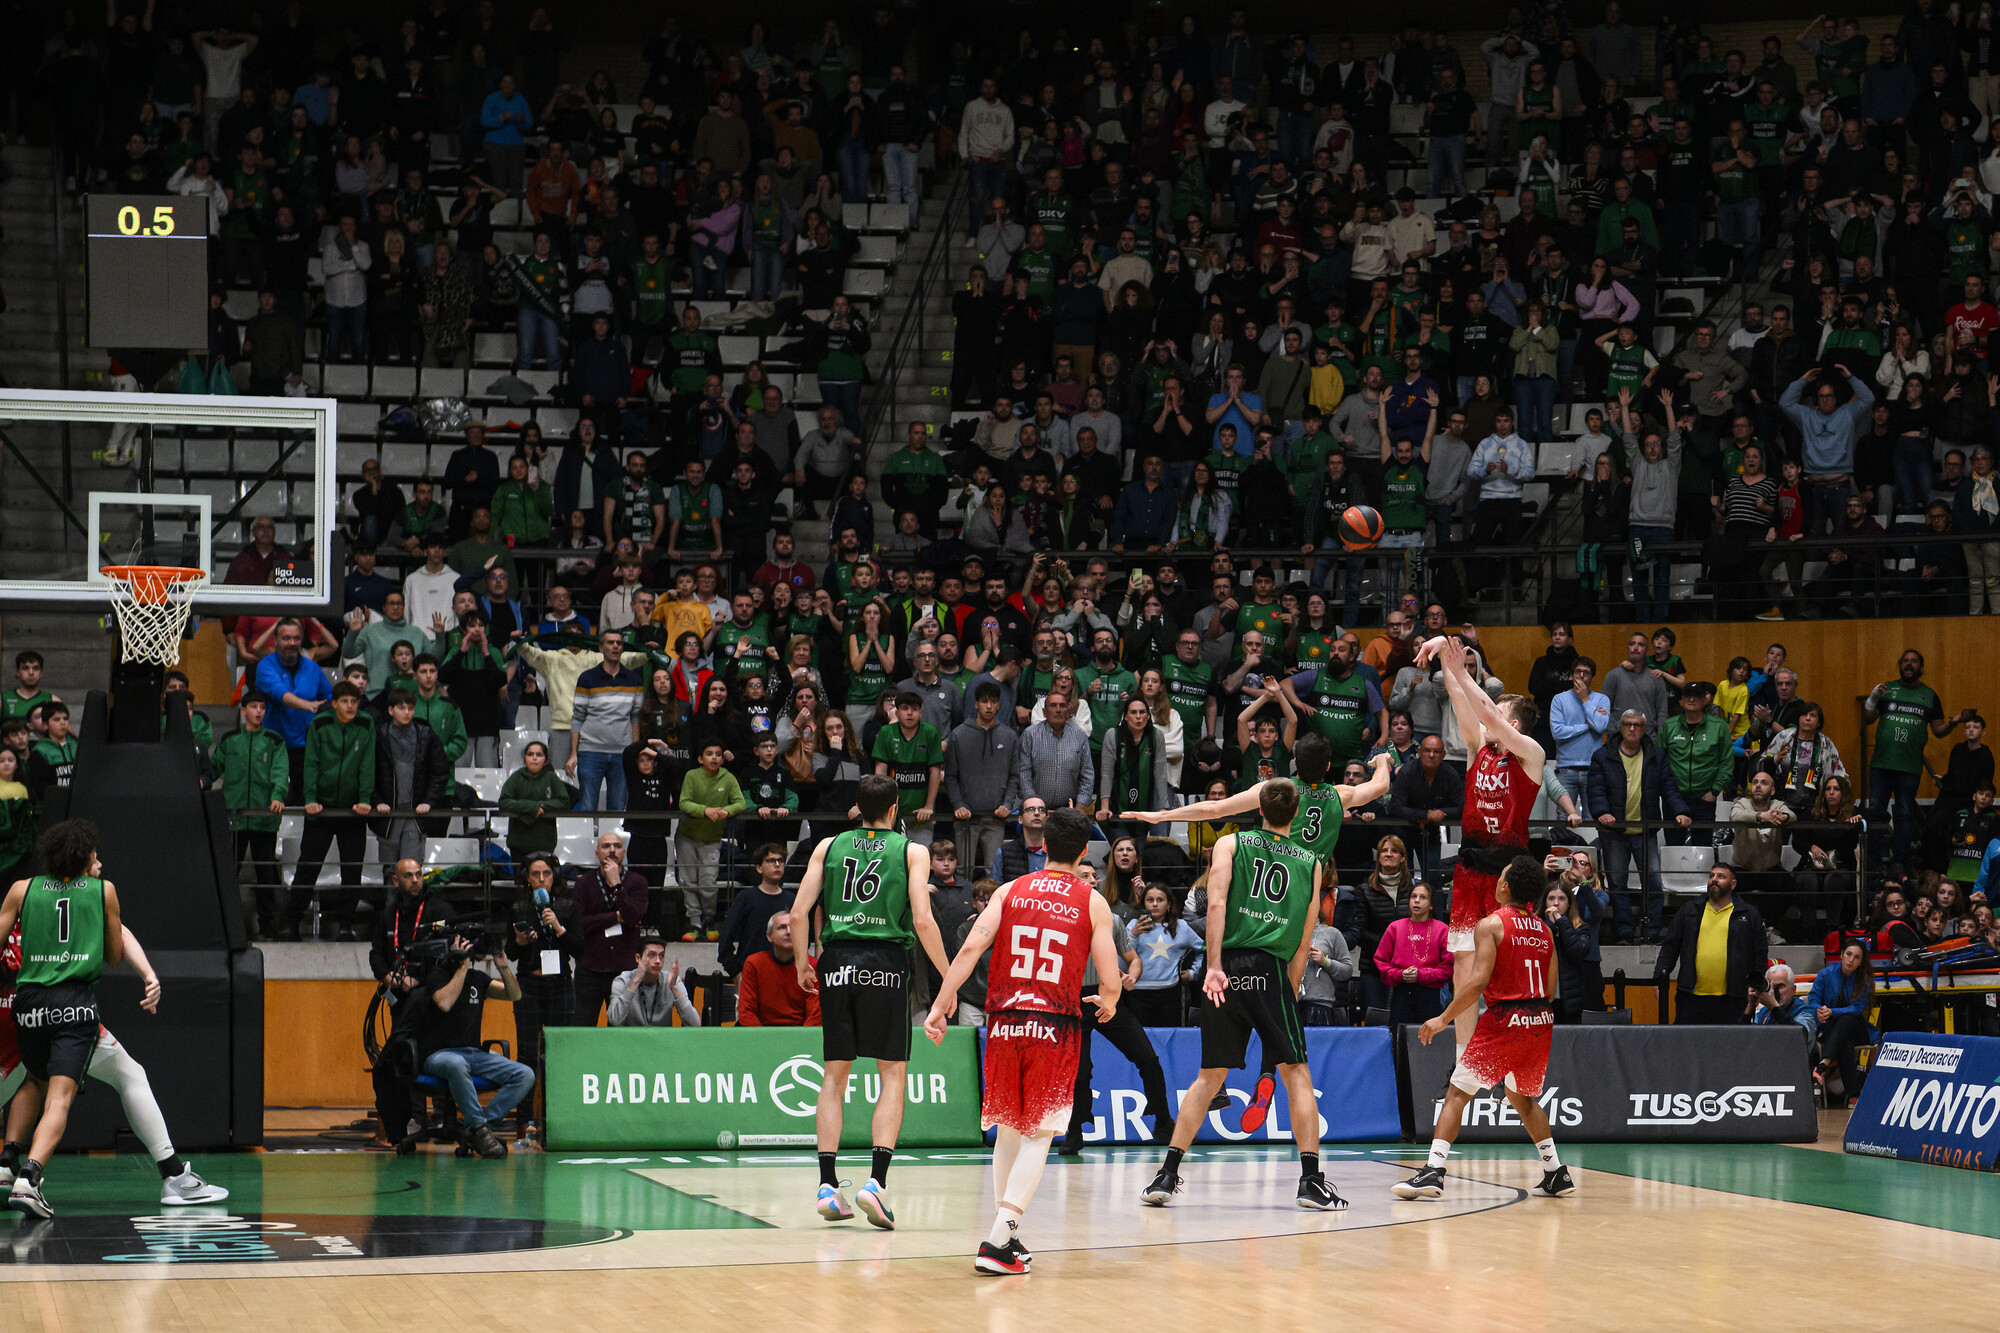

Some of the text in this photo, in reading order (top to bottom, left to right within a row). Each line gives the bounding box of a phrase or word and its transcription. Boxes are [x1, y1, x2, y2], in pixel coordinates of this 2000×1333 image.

[117, 205, 176, 236] 0.5
[1037, 209, 1066, 219] DKV
[930, 385, 948, 397] 21
[1387, 483, 1416, 493] PROBITAS
[274, 567, 293, 583] liga
[274, 575, 313, 586] endesa
[1331, 699, 1360, 709] PROBITAS
[1898, 705, 1925, 716] PROBITAS
[1886, 714, 1923, 725] JOVENTUT
[1894, 726, 1910, 742] 12
[1475, 770, 1510, 791] BAXI
[1128, 787, 1139, 805] 9
[1302, 806, 1322, 843] 3
[1483, 816, 1501, 834] 12
[852, 837, 886, 852] VIVES
[1241, 834, 1312, 863] BRODZIANSKY
[1953, 847, 1982, 859] PROBITAS
[43, 879, 88, 892] KRAAG
[842, 856, 882, 904] 16
[1029, 878, 1073, 897] PÉREZ
[1250, 857, 1290, 904] 10
[1011, 895, 1080, 919] inmoovs
[56, 897, 71, 943] 1
[866, 917, 887, 925] FUTUR
[1511, 917, 1544, 933] TAYLOR
[71, 953, 89, 961] FUTUR
[1010, 924, 1069, 985] 55
[824, 965, 902, 989] vdfteam
[1524, 958, 1545, 999] 11
[989, 1020, 1058, 1043] Aquaflix
[1879, 1043, 1961, 1068] Pintura y Decoración
[582, 1072, 948, 1104] BADALONA FUUR
[743, 1136, 777, 1145] Ajuntament
[778, 1136, 787, 1144] de
[1921, 1144, 1983, 1171] TIENDAS
